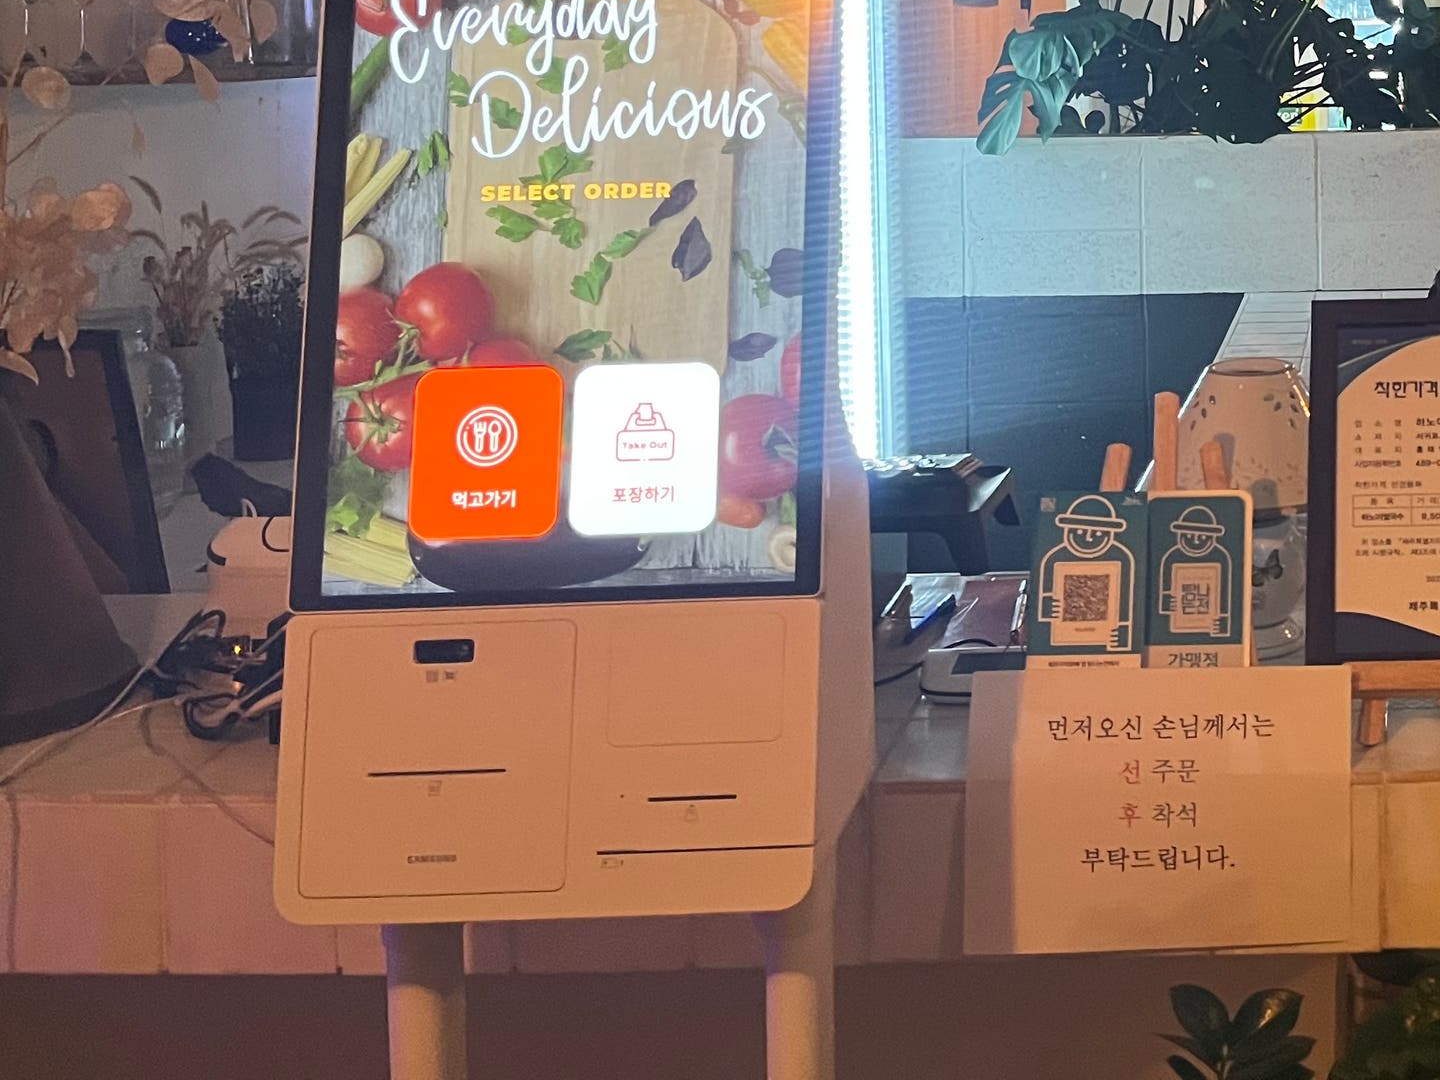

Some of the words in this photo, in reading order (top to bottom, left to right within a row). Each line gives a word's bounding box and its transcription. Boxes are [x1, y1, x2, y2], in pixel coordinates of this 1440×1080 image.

[468, 55, 774, 159] Delicious
[480, 183, 576, 203] SELECT
[584, 181, 672, 200] ORDER
[622, 442, 647, 450] Take
[649, 441, 668, 450] Out
[452, 489, 517, 509] 먹고가기
[612, 486, 676, 504] 포장하기
[1048, 715, 1143, 741] 먼저오신
[1152, 713, 1275, 739] 손님께서는
[1120, 760, 1142, 785] 선
[1151, 759, 1201, 784] 주문
[1118, 802, 1142, 826] 후
[1151, 802, 1198, 828] 착석
[1081, 845, 1236, 872] 부탁드립니다.
